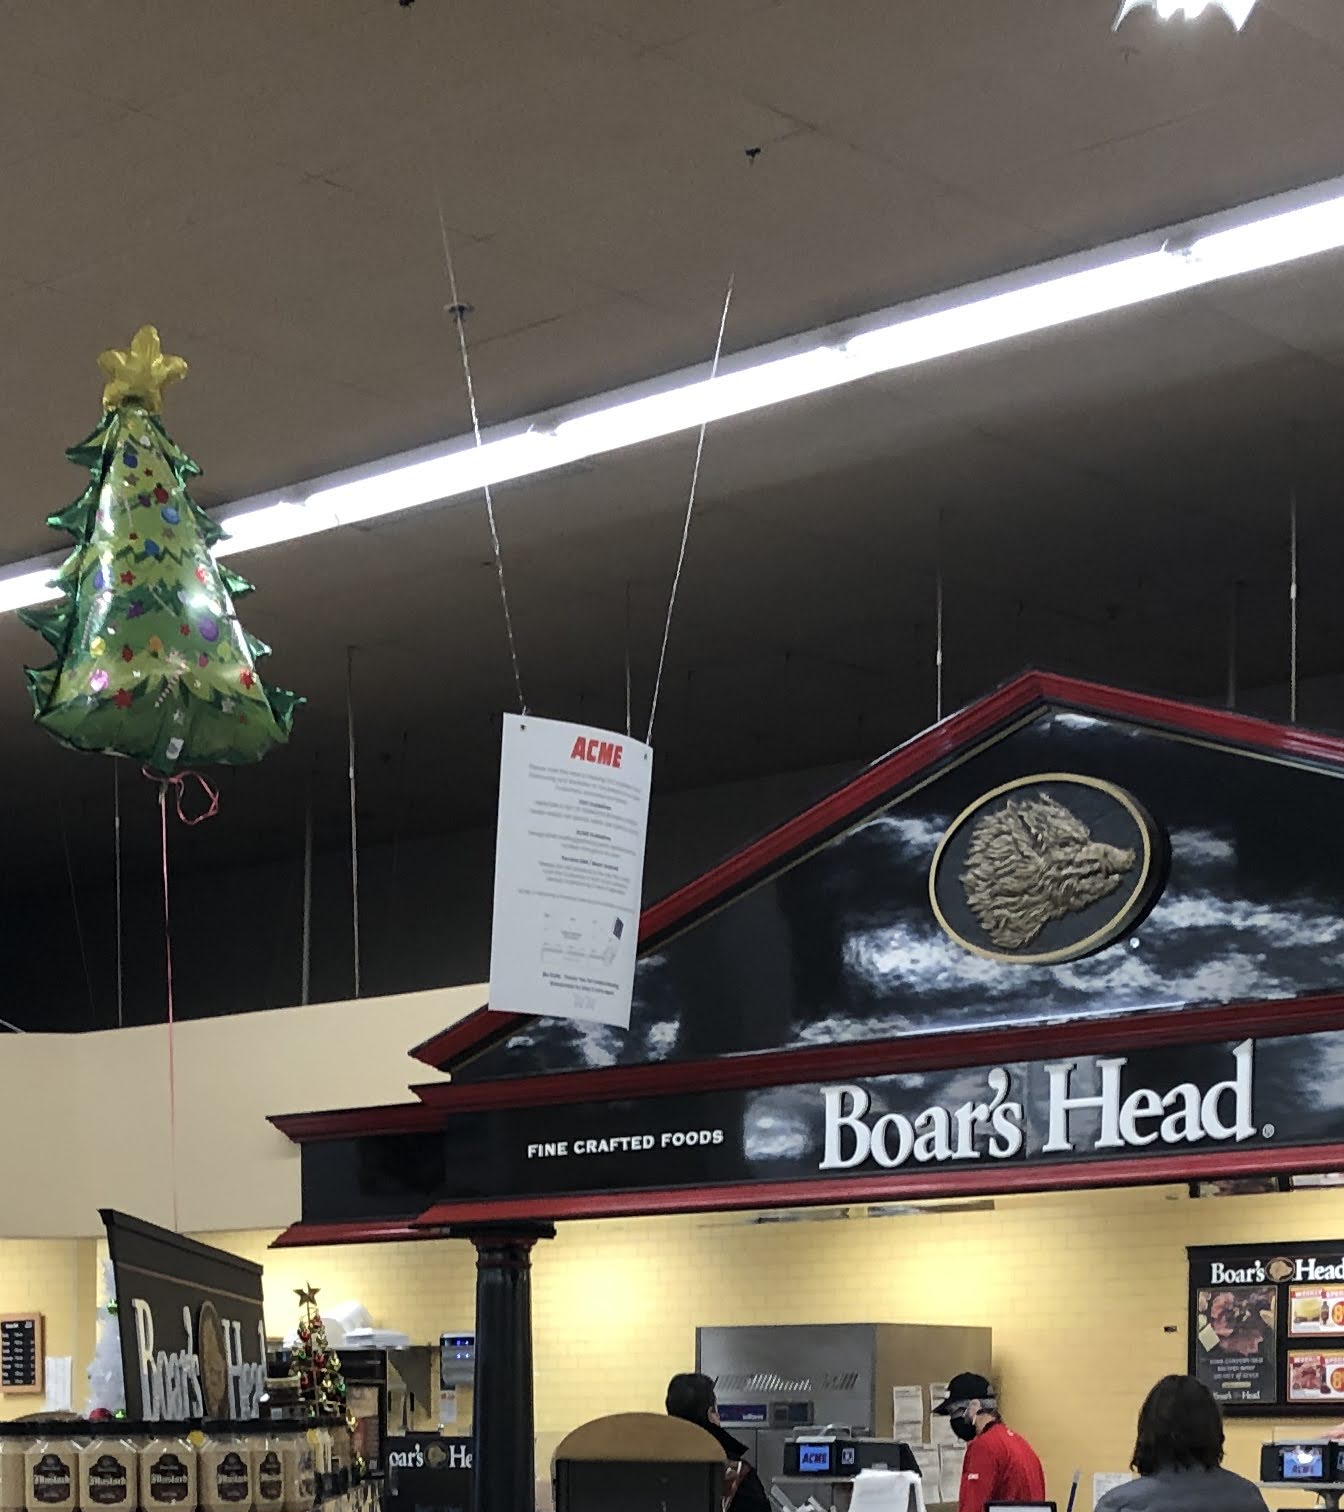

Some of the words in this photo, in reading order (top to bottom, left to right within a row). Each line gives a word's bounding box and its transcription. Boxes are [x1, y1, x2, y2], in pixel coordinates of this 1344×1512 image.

[570, 735, 624, 769] ACME
[819, 1066, 1025, 1171] Boar's
[1041, 1038, 1257, 1153] Head
[526, 1142, 568, 1160] FINE
[572, 1134, 656, 1156] CRAFTED
[659, 1128, 724, 1150] FOODS
[1210, 1258, 1266, 1285] Boar's
[131, 1298, 204, 1422] Boar's
[388, 1443, 424, 1468] oar's
